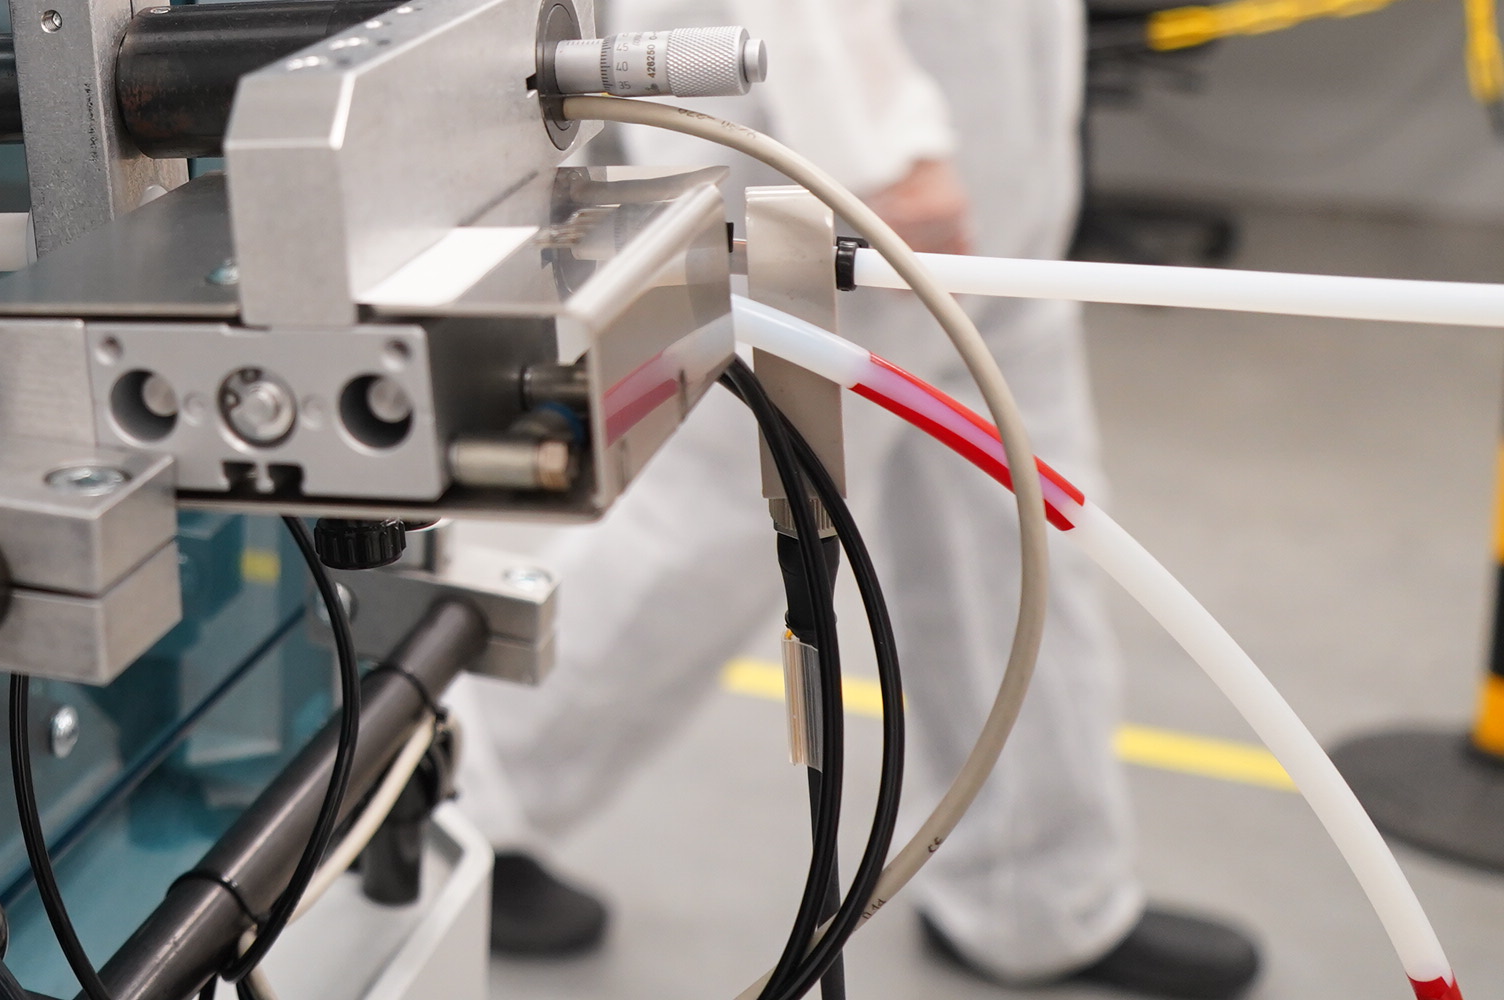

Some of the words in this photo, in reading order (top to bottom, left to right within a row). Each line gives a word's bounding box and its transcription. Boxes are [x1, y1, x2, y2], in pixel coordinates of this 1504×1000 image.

[616, 42, 629, 52] 45
[615, 61, 629, 72] 40
[618, 80, 632, 90] 35
